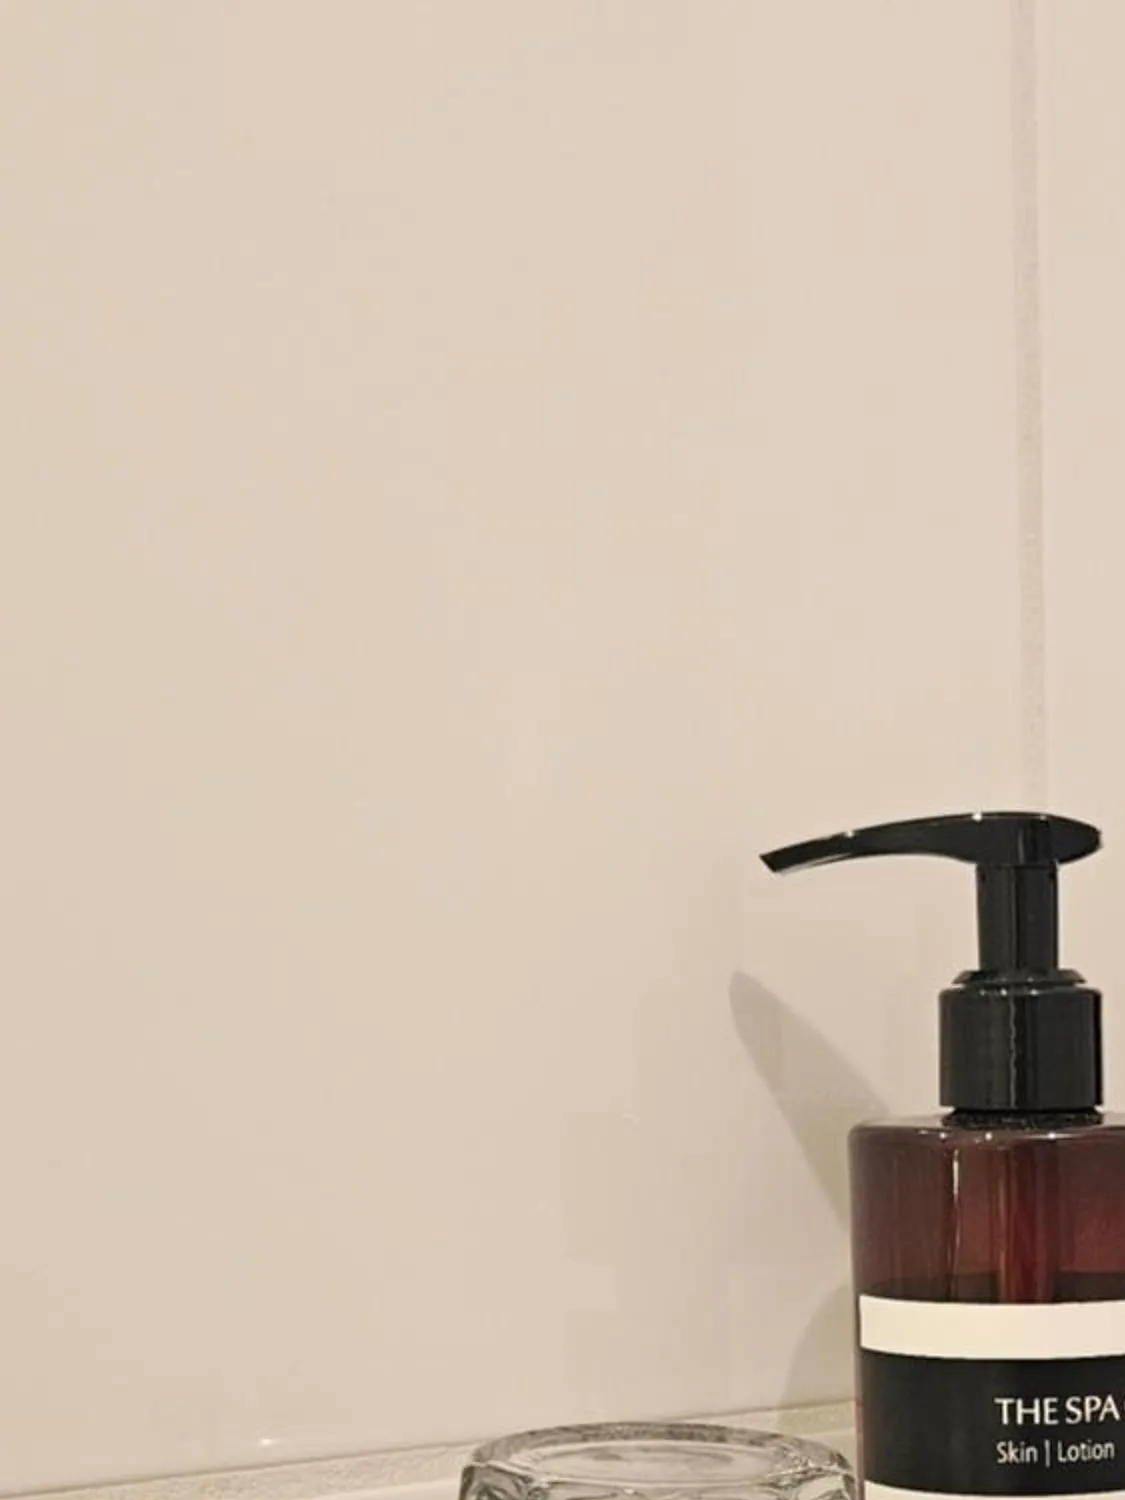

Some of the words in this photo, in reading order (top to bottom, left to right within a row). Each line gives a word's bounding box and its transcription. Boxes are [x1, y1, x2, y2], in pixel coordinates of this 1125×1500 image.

[994, 1397, 1058, 1425] THE
[1065, 1394, 1121, 1424] SPA
[996, 1441, 1038, 1464] Skin
[1057, 1439, 1115, 1463] Lotion
